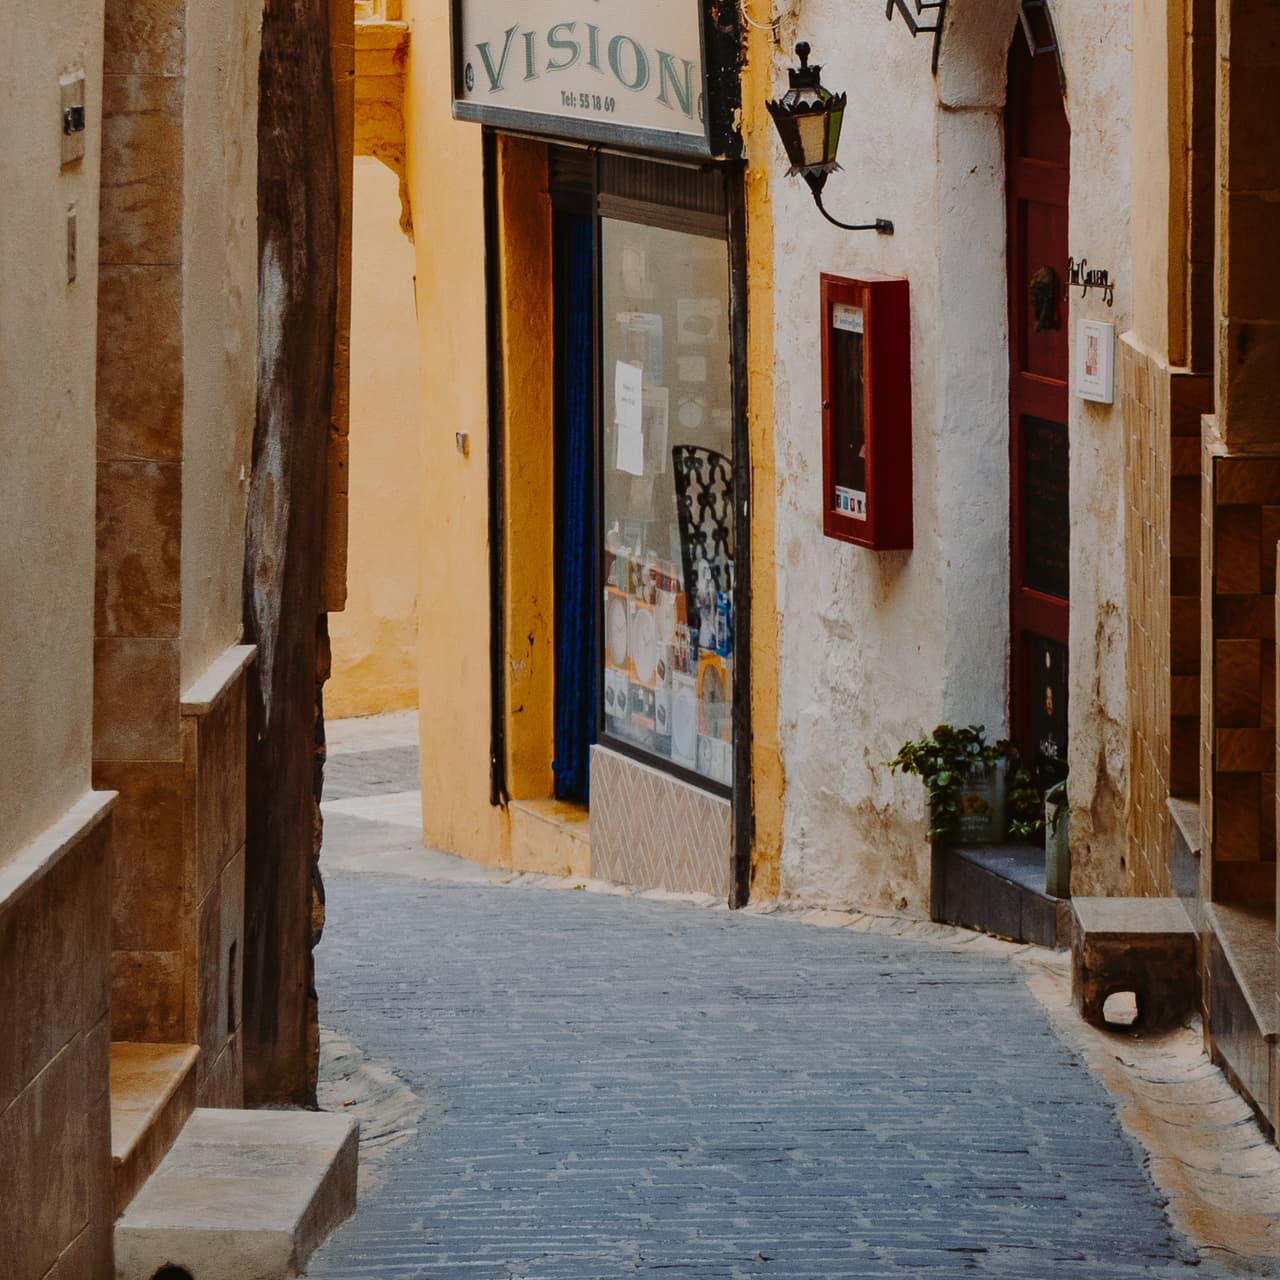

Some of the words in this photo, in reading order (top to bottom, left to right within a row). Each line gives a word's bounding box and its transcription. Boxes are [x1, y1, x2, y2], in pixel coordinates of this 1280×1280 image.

[475, 21, 695, 120] VISION
[561, 91, 577, 108] Tel:
[579, 93, 590, 109] 55
[591, 94, 602, 111] 18
[604, 96, 615, 112] 69
